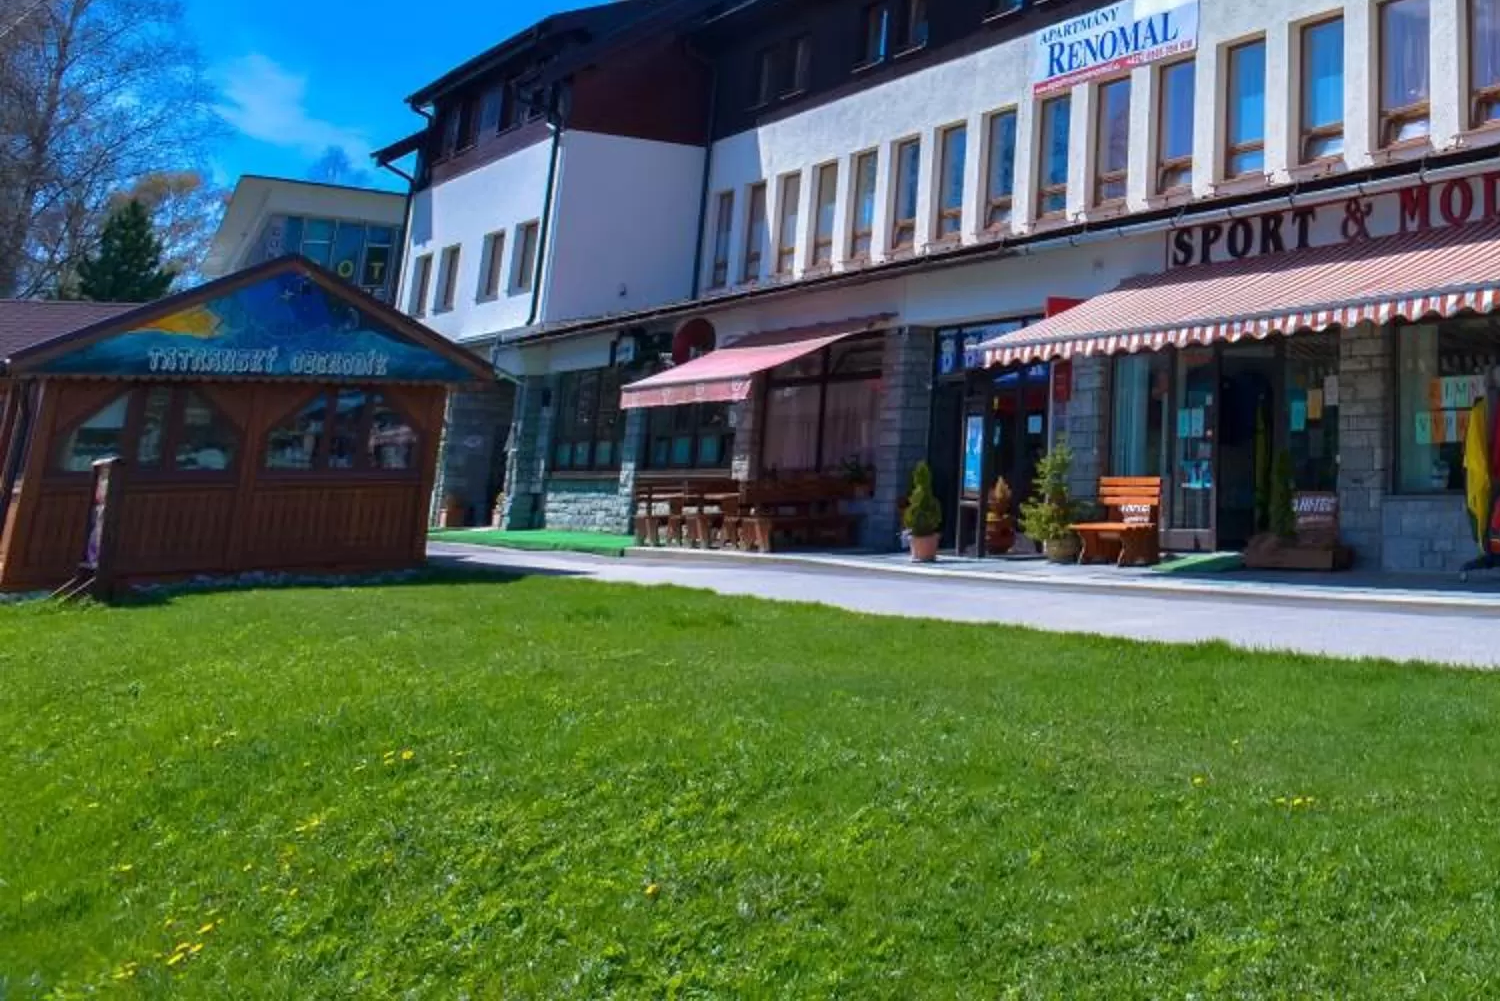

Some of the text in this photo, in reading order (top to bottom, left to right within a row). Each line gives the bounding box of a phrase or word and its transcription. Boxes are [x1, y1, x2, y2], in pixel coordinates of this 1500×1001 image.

[1047, 12, 1179, 79] RENOMAL
[1172, 206, 1317, 267] SPORT
[1341, 197, 1373, 243] &
